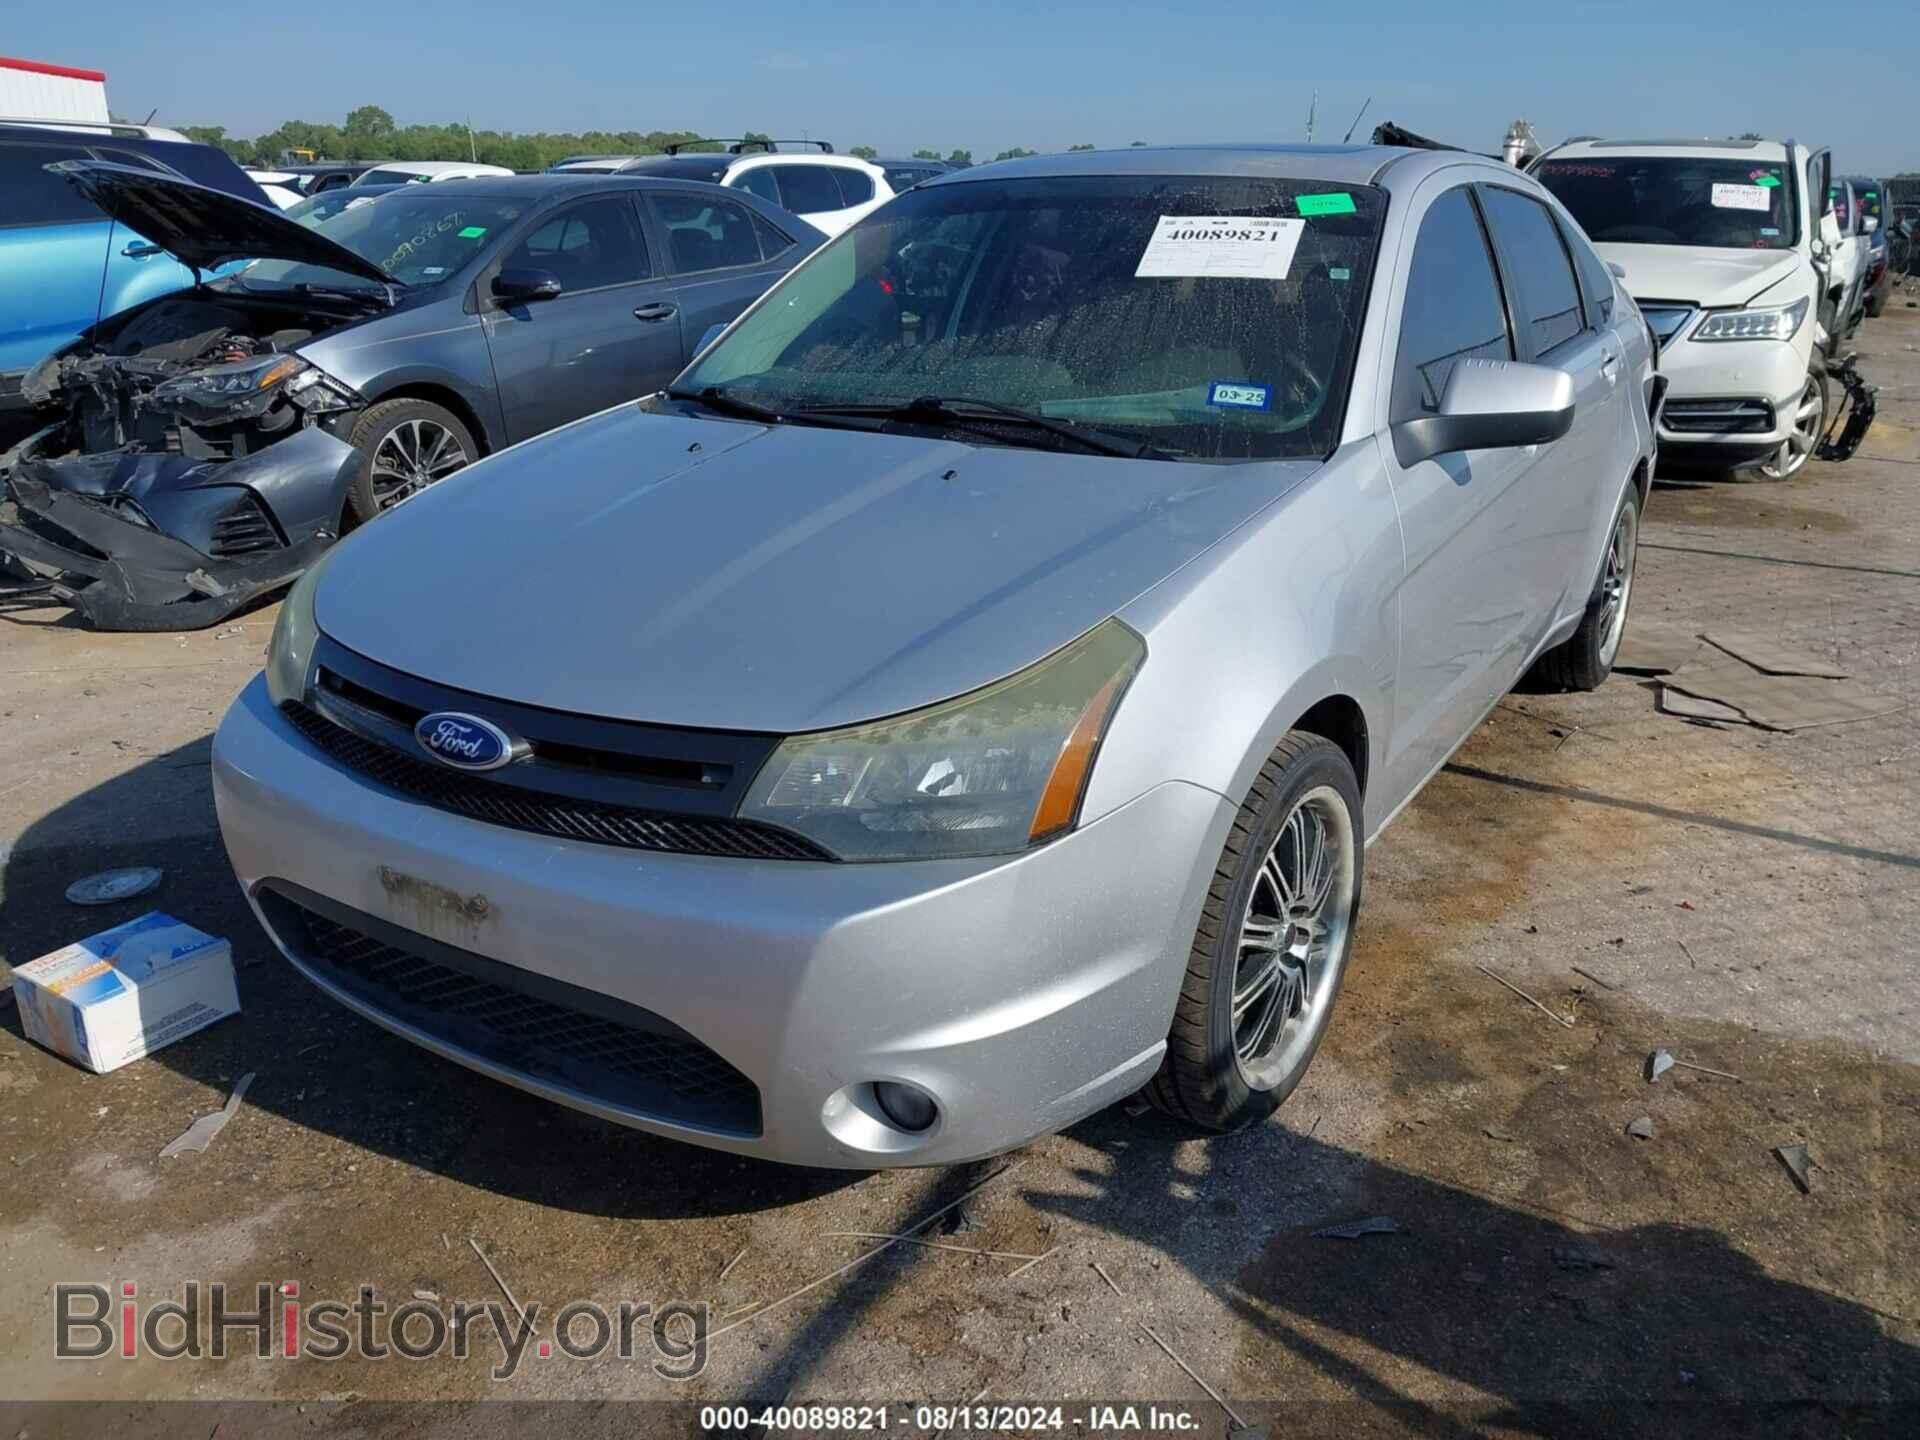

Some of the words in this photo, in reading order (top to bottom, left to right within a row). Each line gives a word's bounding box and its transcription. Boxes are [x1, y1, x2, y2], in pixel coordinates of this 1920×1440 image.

[1167, 228, 1279, 241] 40089821
[1219, 390, 1239, 400] 03
[1245, 392, 1265, 402] 25
[430, 720, 482, 759] Ford
